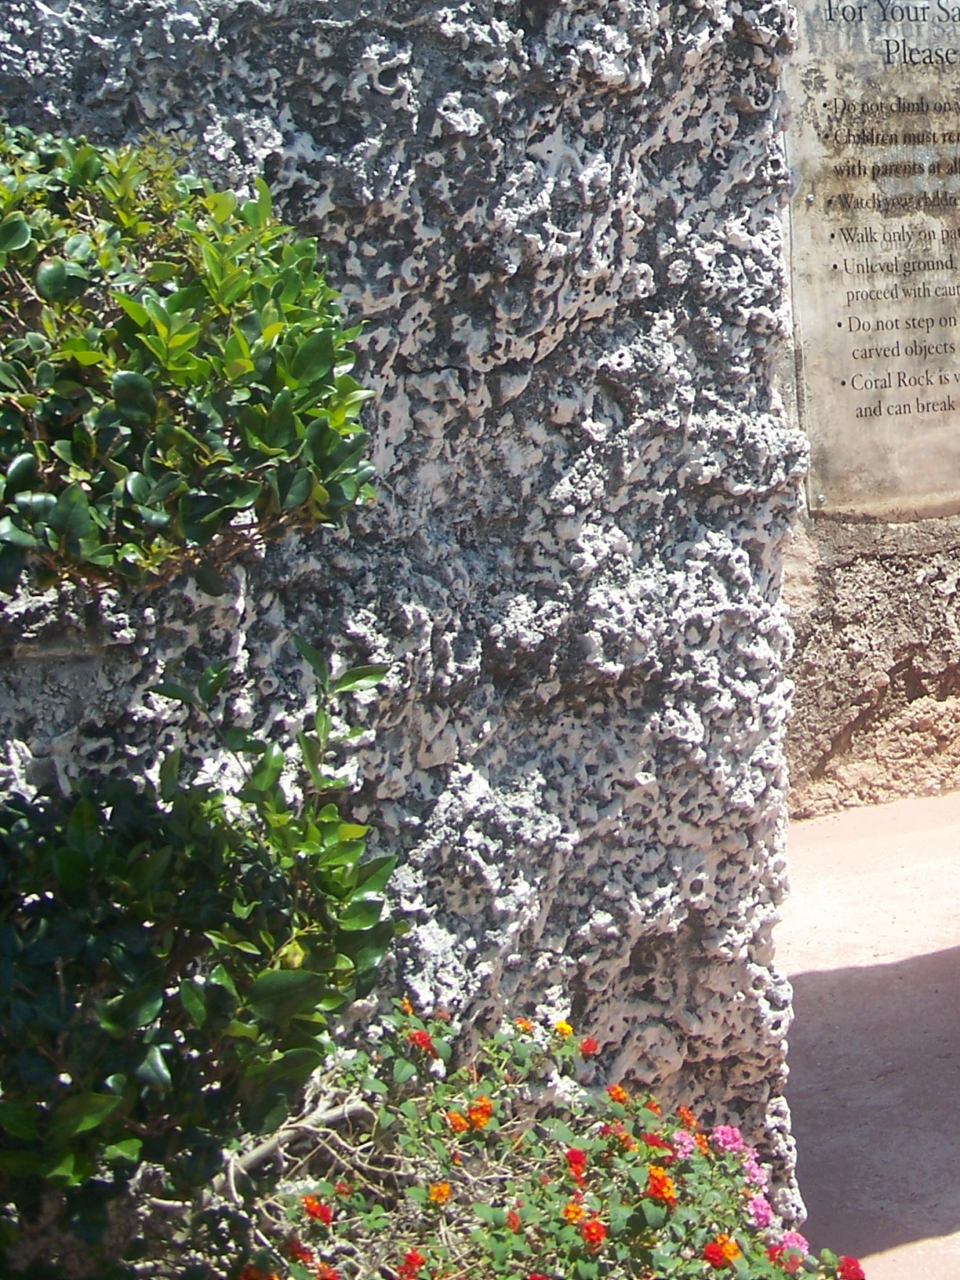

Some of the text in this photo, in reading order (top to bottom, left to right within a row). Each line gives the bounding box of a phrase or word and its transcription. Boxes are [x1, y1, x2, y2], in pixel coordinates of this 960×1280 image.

[879, 0, 930, 23] Your
[834, 98, 856, 113] Do
[861, 102, 885, 113] not
[890, 97, 929, 113] climb
[934, 101, 951, 111] on
[834, 130, 897, 145] Children
[903, 131, 938, 145] must
[835, 160, 866, 177] with
[872, 160, 924, 180] parents
[928, 161, 941, 173] at
[838, 193, 880, 210] Watch
[884, 197, 913, 213] your
[840, 226, 878, 244] Walk
[883, 225, 915, 245] only
[918, 228, 936, 240] on
[842, 258, 898, 275] Unlevel
[846, 285, 898, 306] proceed
[902, 284, 931, 298] with
[848, 314, 957, 335] Do not step on
[852, 340, 956, 360] carved objects
[851, 372, 892, 391] Coral
[897, 370, 933, 388] Rock
[939, 370, 949, 385] is
[855, 396, 956, 418] and can break
